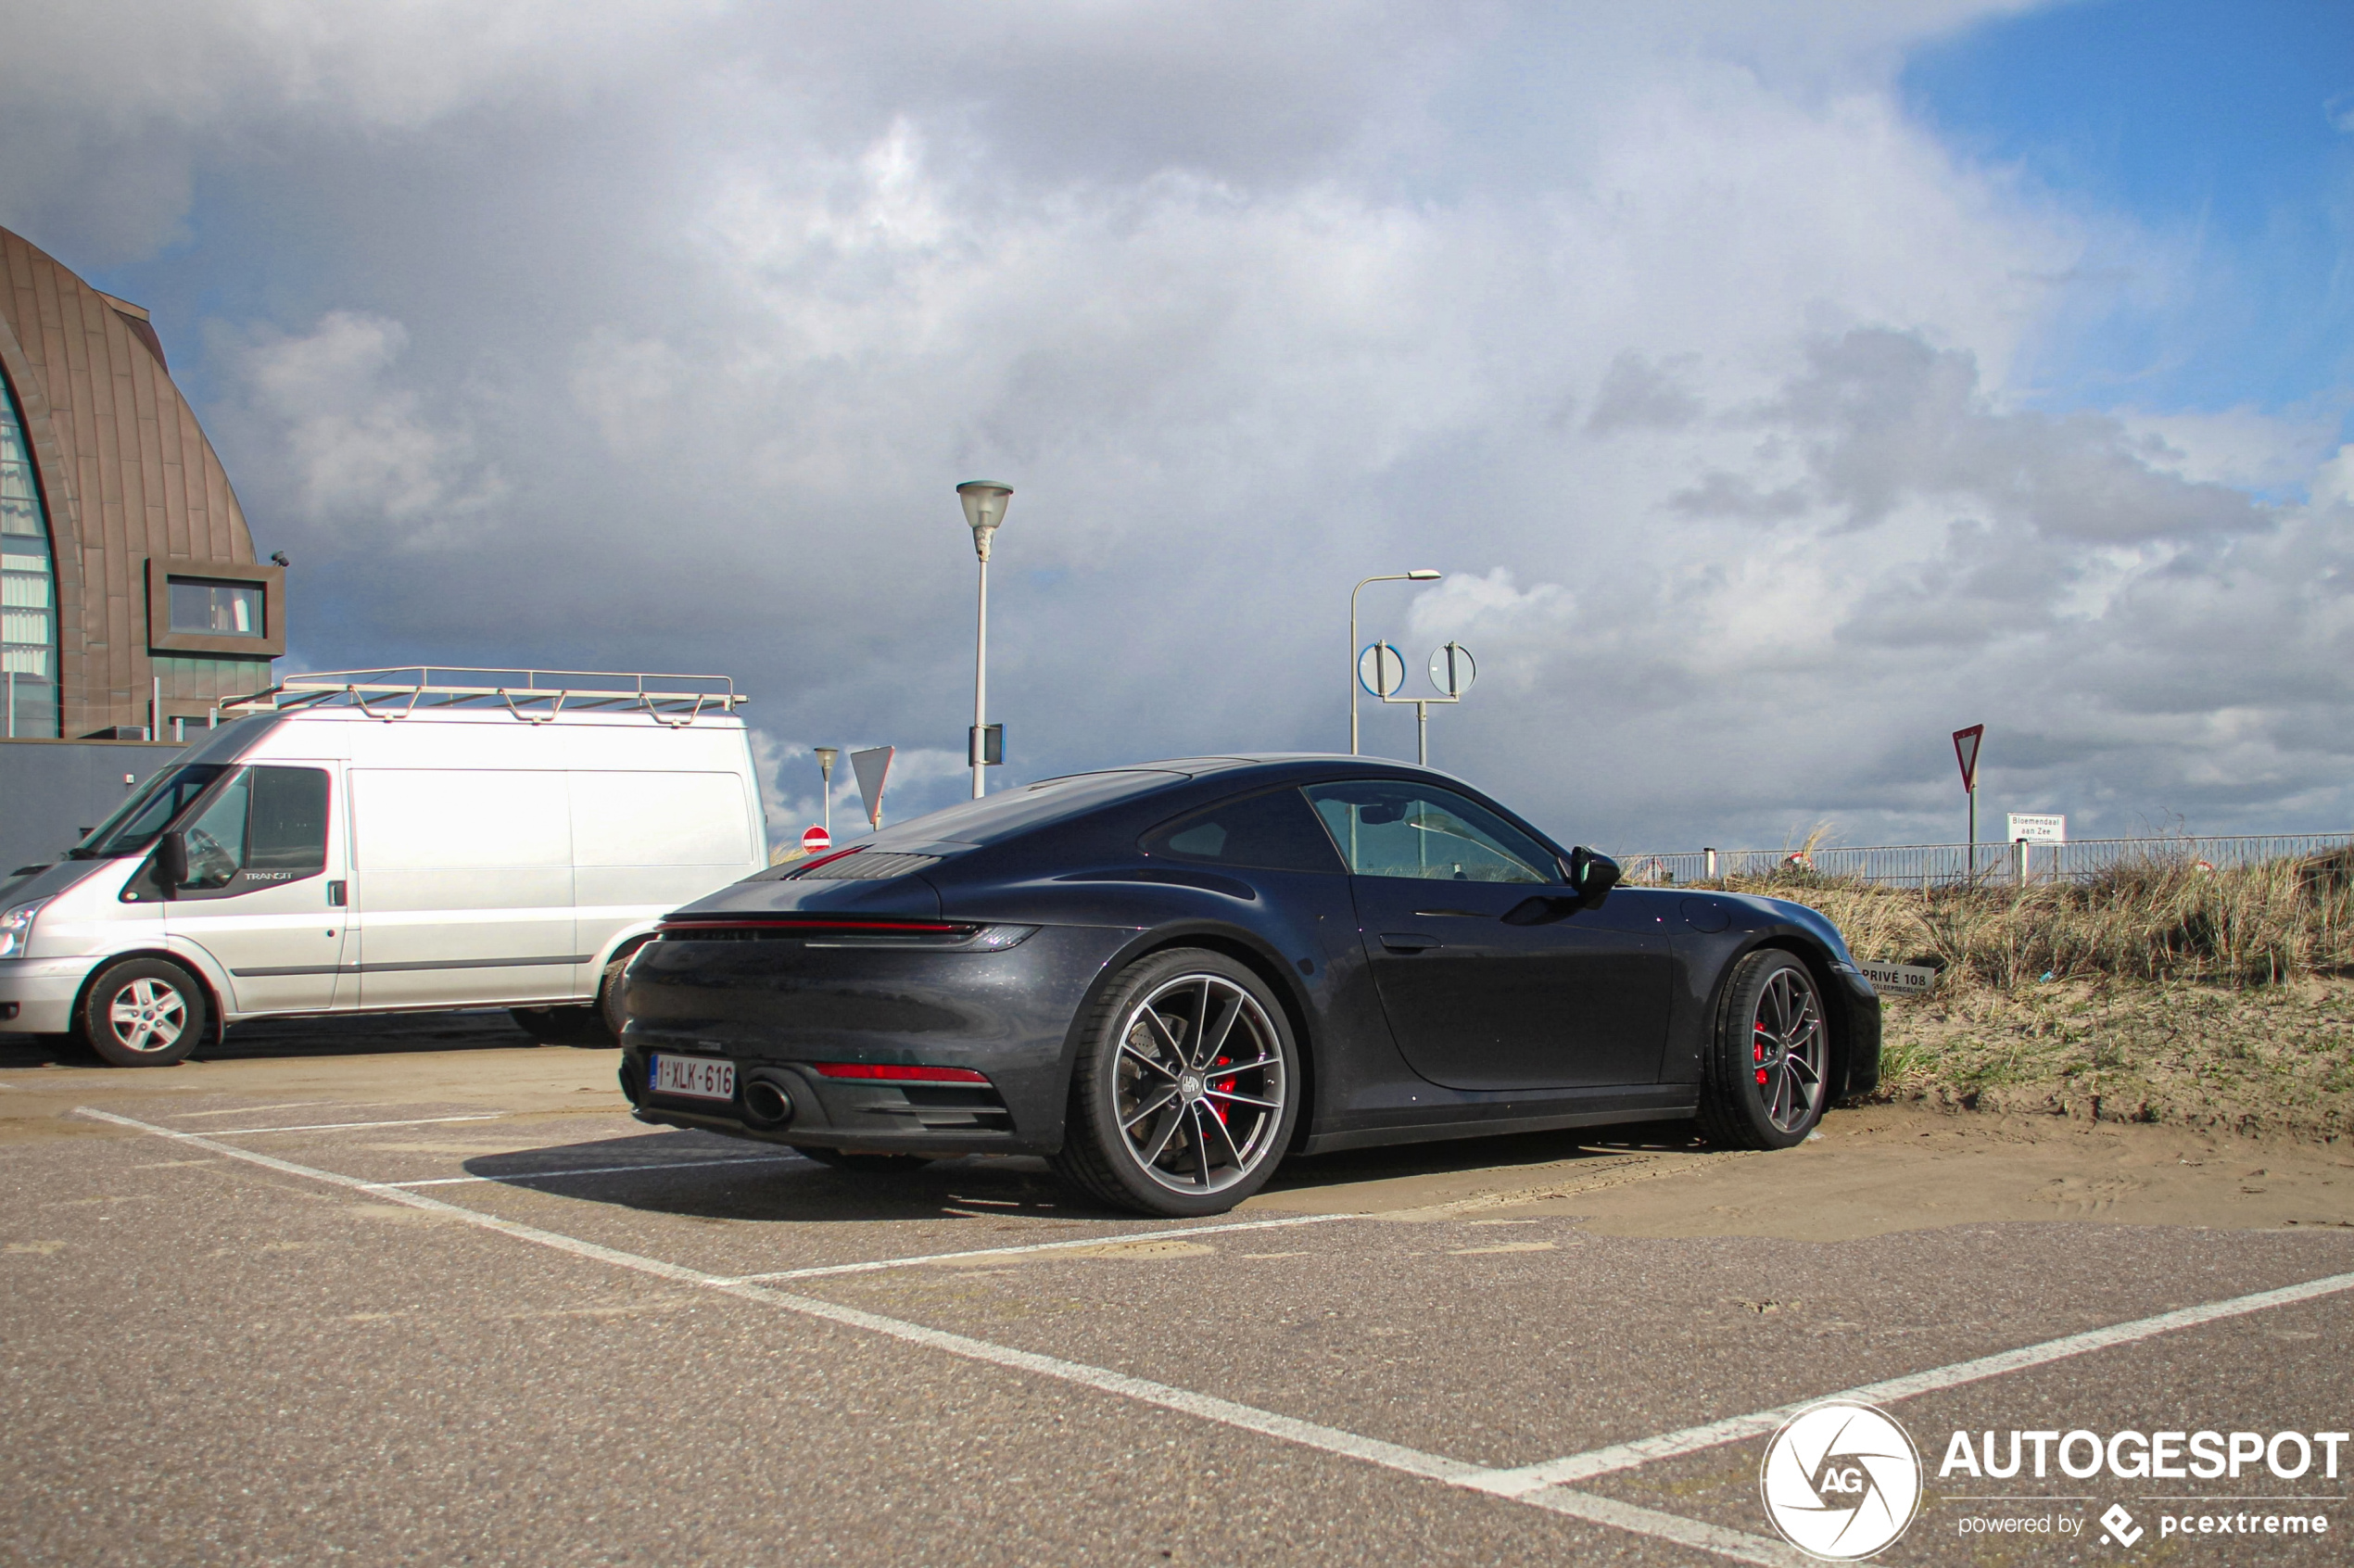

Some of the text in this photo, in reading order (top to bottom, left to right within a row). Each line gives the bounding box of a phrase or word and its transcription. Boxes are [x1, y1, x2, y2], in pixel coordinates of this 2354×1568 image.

[2012, 816, 2059, 826] Bloemendaal
[245, 872, 293, 880] TRANSIT
[1862, 969, 1926, 986] PRIVÉ 108
[659, 1060, 732, 1094] 1-XLK-616
